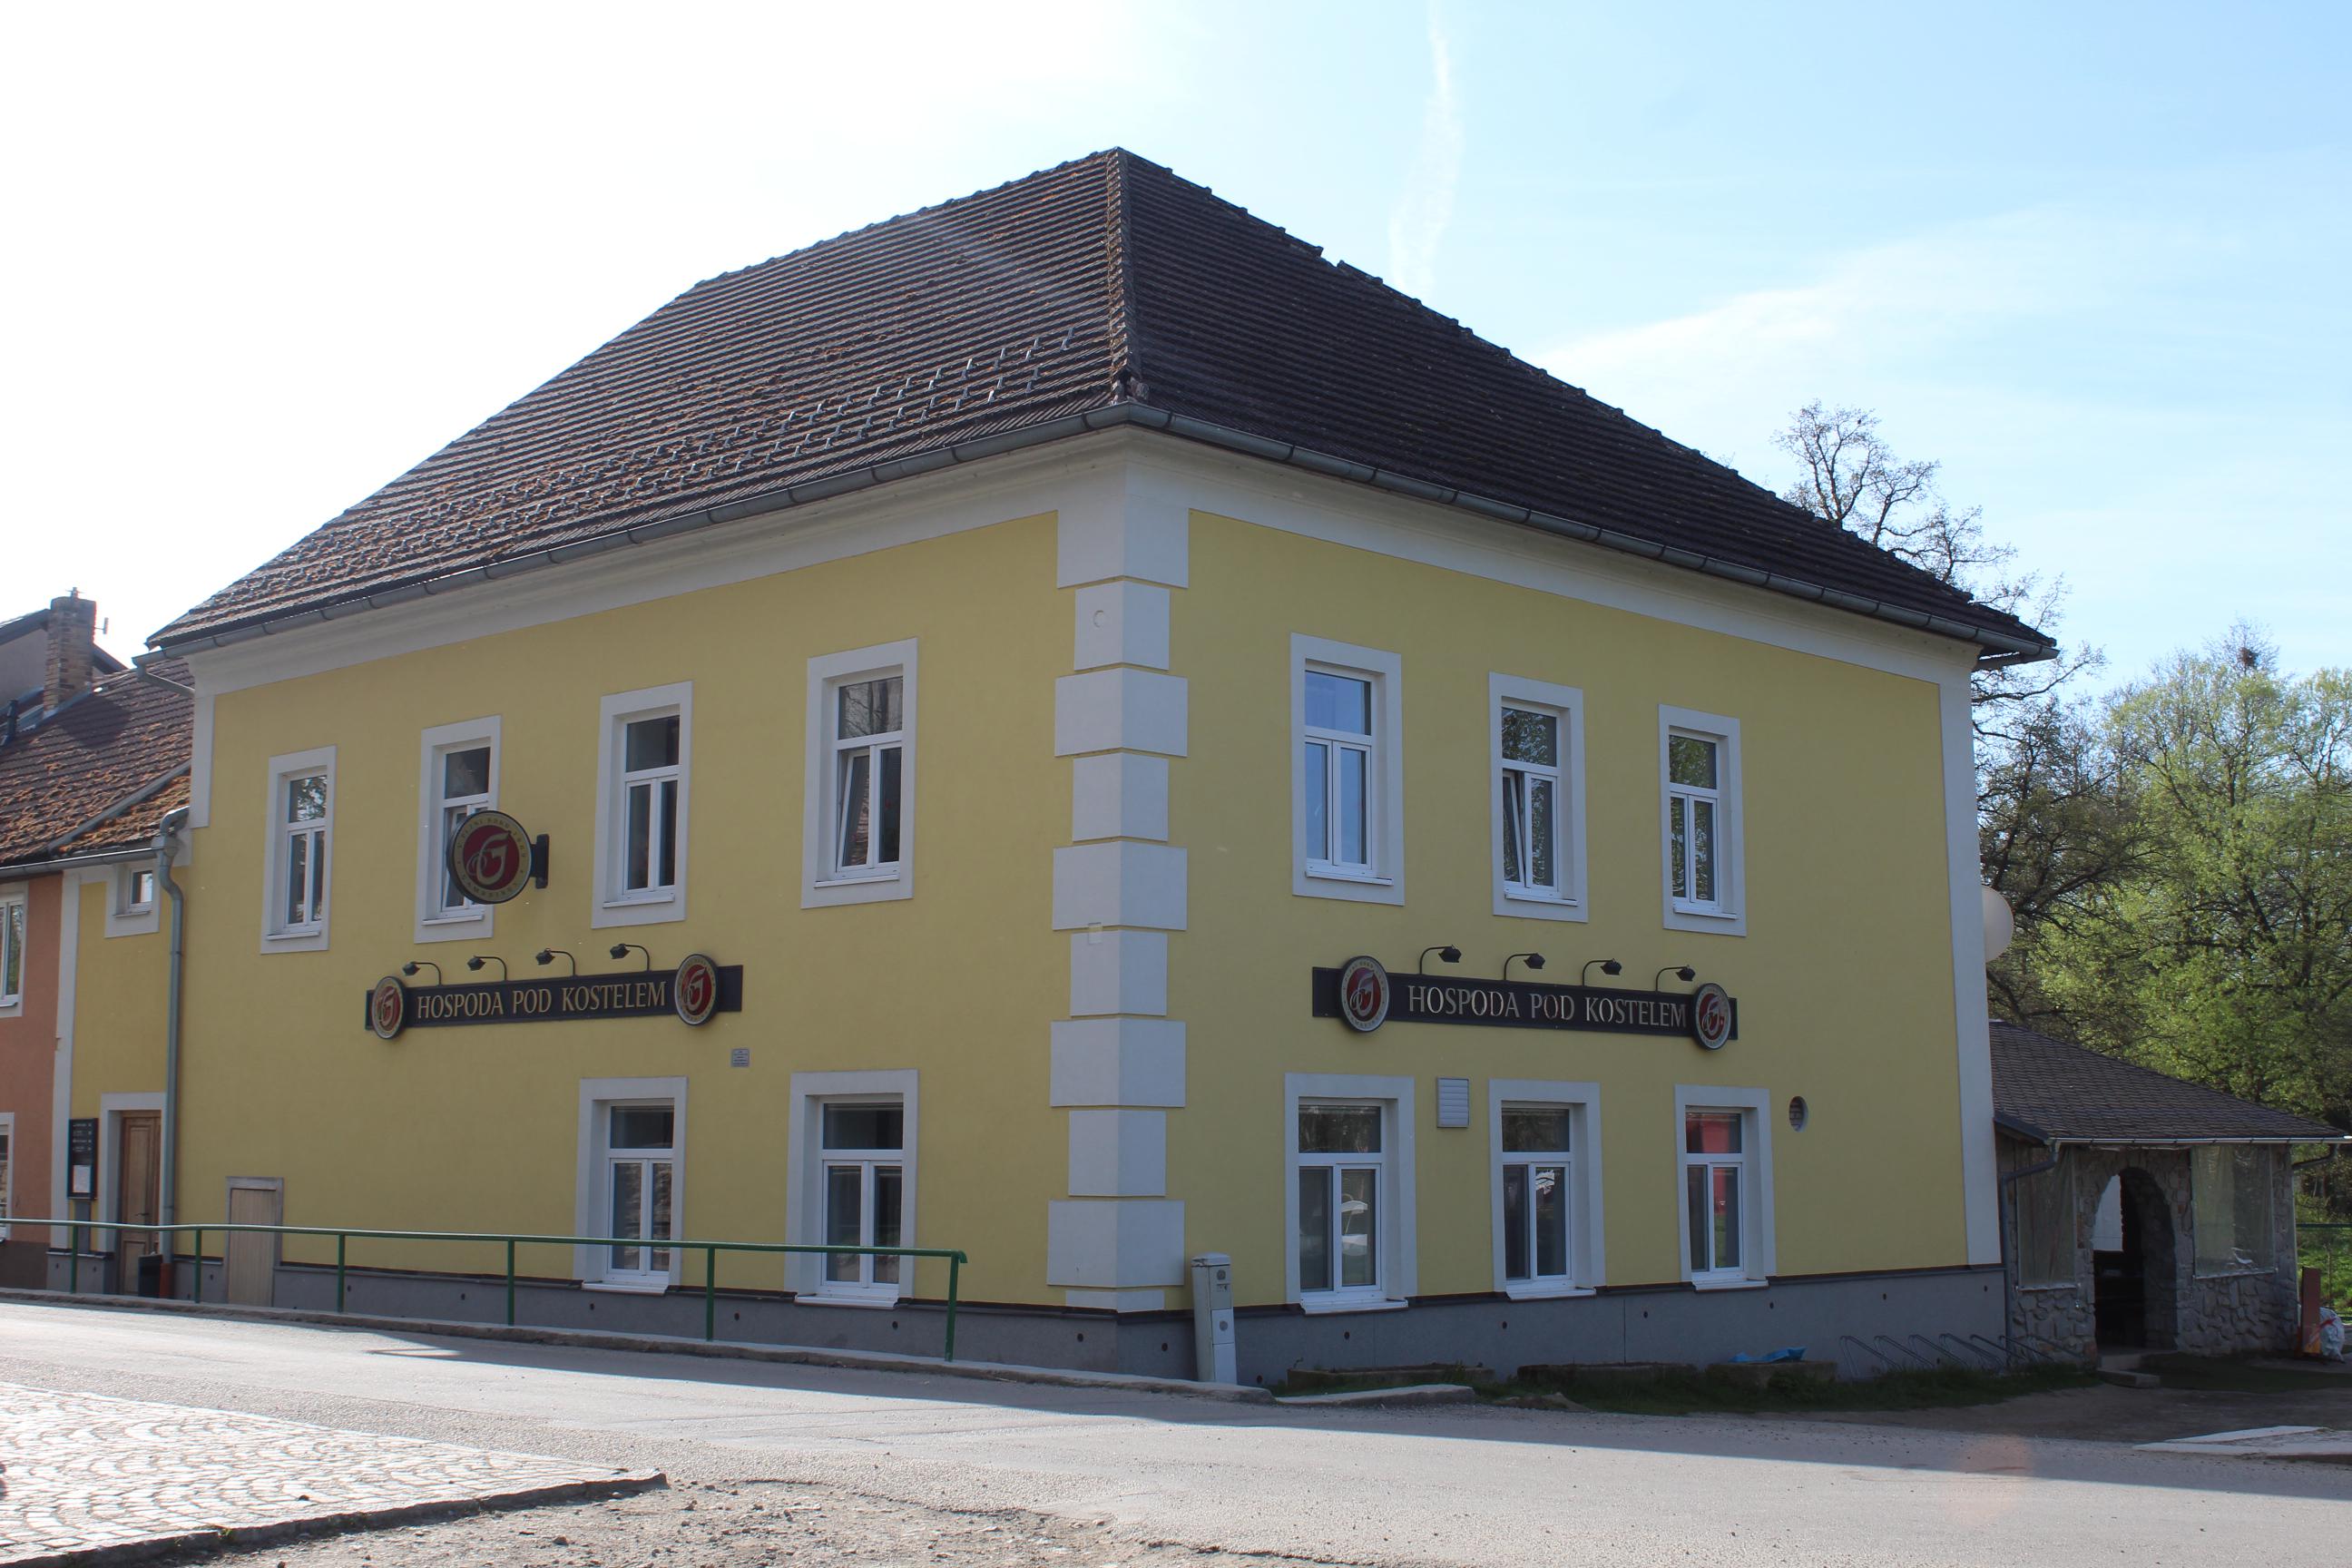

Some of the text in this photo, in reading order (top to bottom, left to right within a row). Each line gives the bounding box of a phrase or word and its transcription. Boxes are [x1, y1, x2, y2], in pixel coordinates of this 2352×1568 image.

[417, 991, 504, 1019] HOSPODA
[513, 988, 552, 1014] POD
[562, 981, 666, 1012] KOSTELEM
[1408, 985, 1520, 1018] HOSPODA
[1530, 994, 1575, 1021] POD
[1585, 997, 1687, 1027] KOSTELEM
